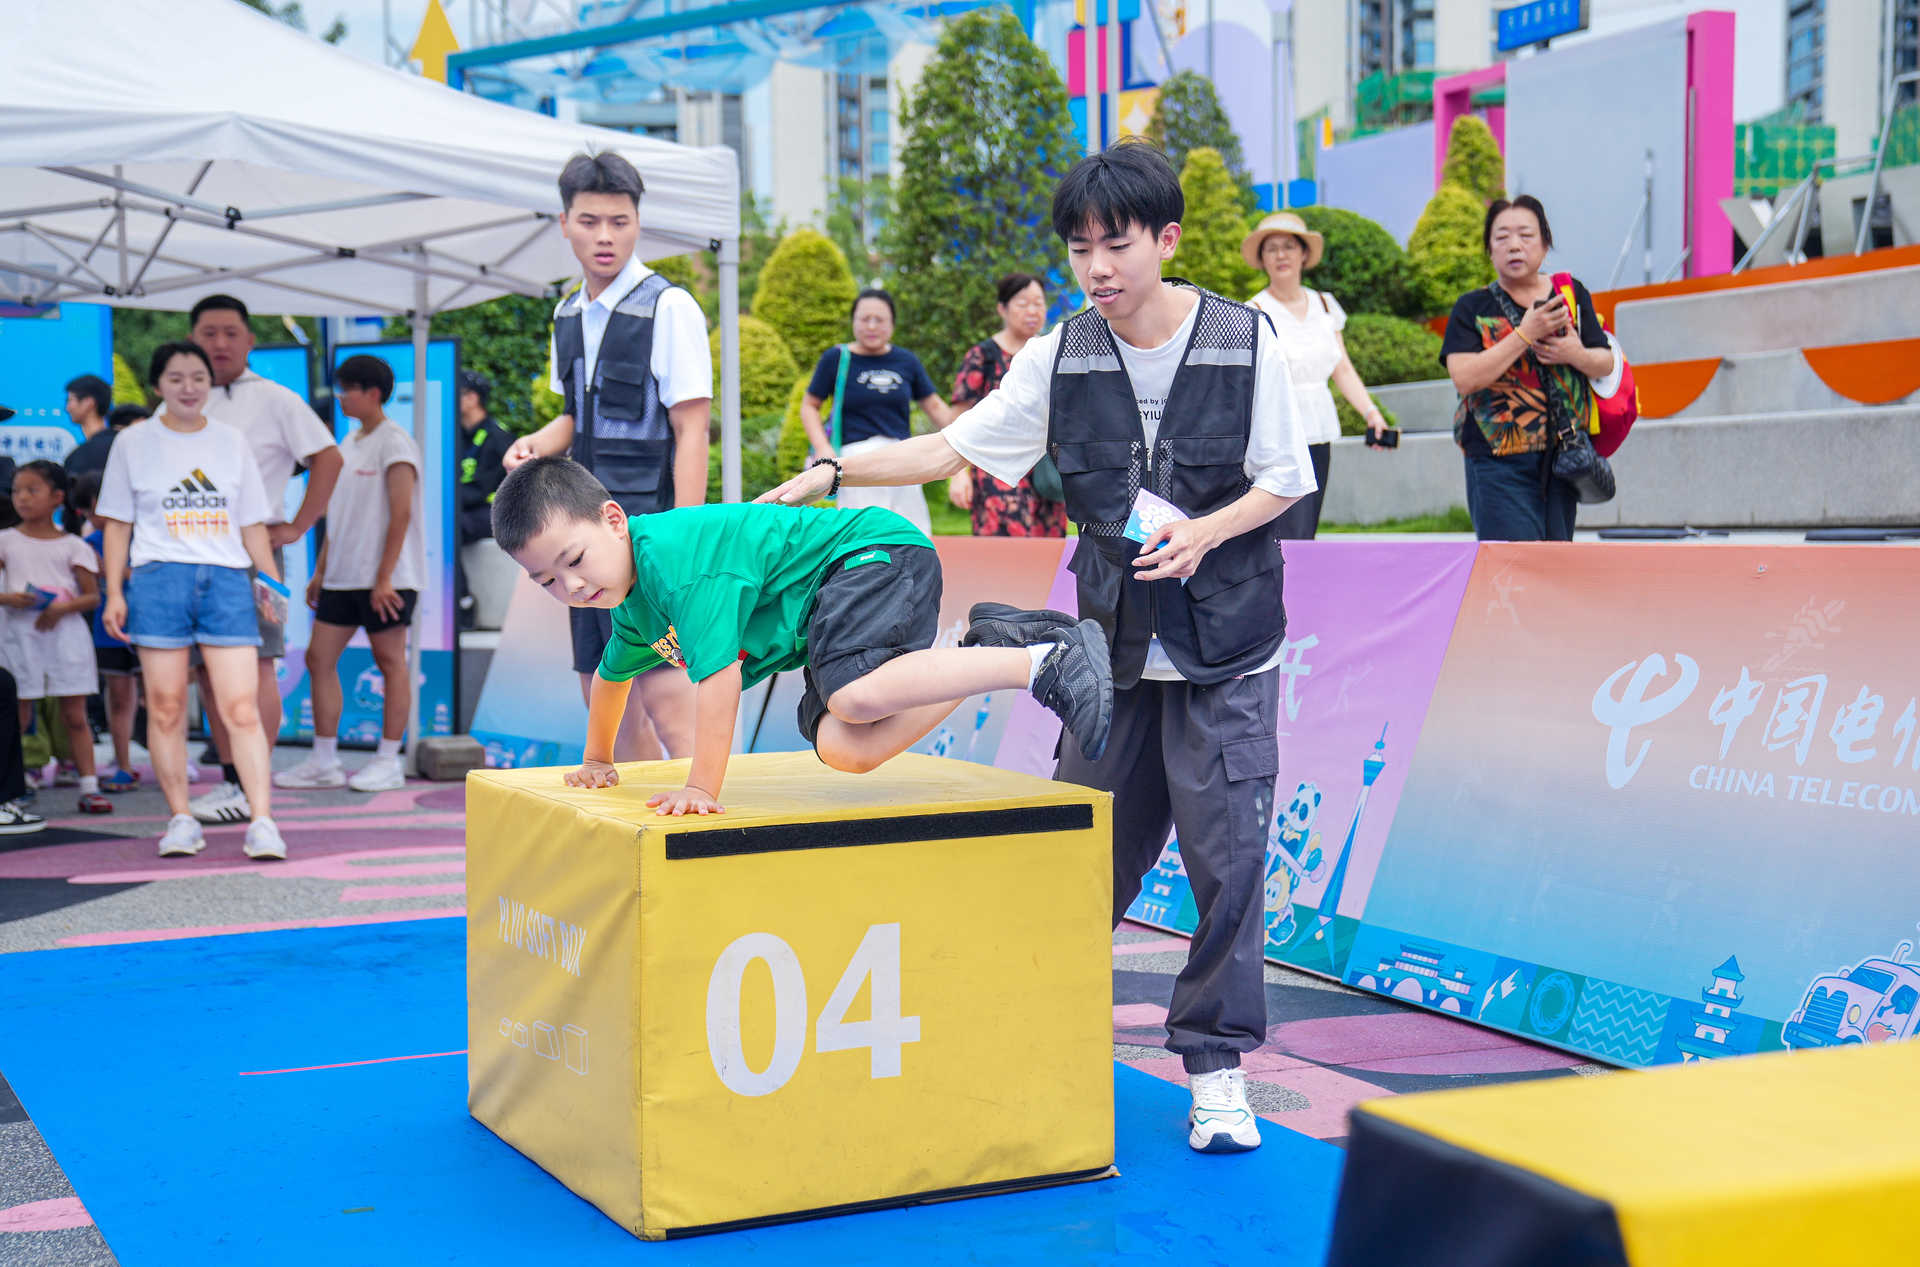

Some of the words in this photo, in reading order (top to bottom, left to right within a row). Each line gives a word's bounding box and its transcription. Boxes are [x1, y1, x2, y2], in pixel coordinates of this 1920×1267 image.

[1139, 410, 1161, 420] YIU
[161, 494, 228, 510] adidas
[1688, 764, 1776, 798] CHINA
[526, 907, 557, 963] SOFT
[559, 920, 587, 977] BOX
[705, 921, 921, 1097] 04
